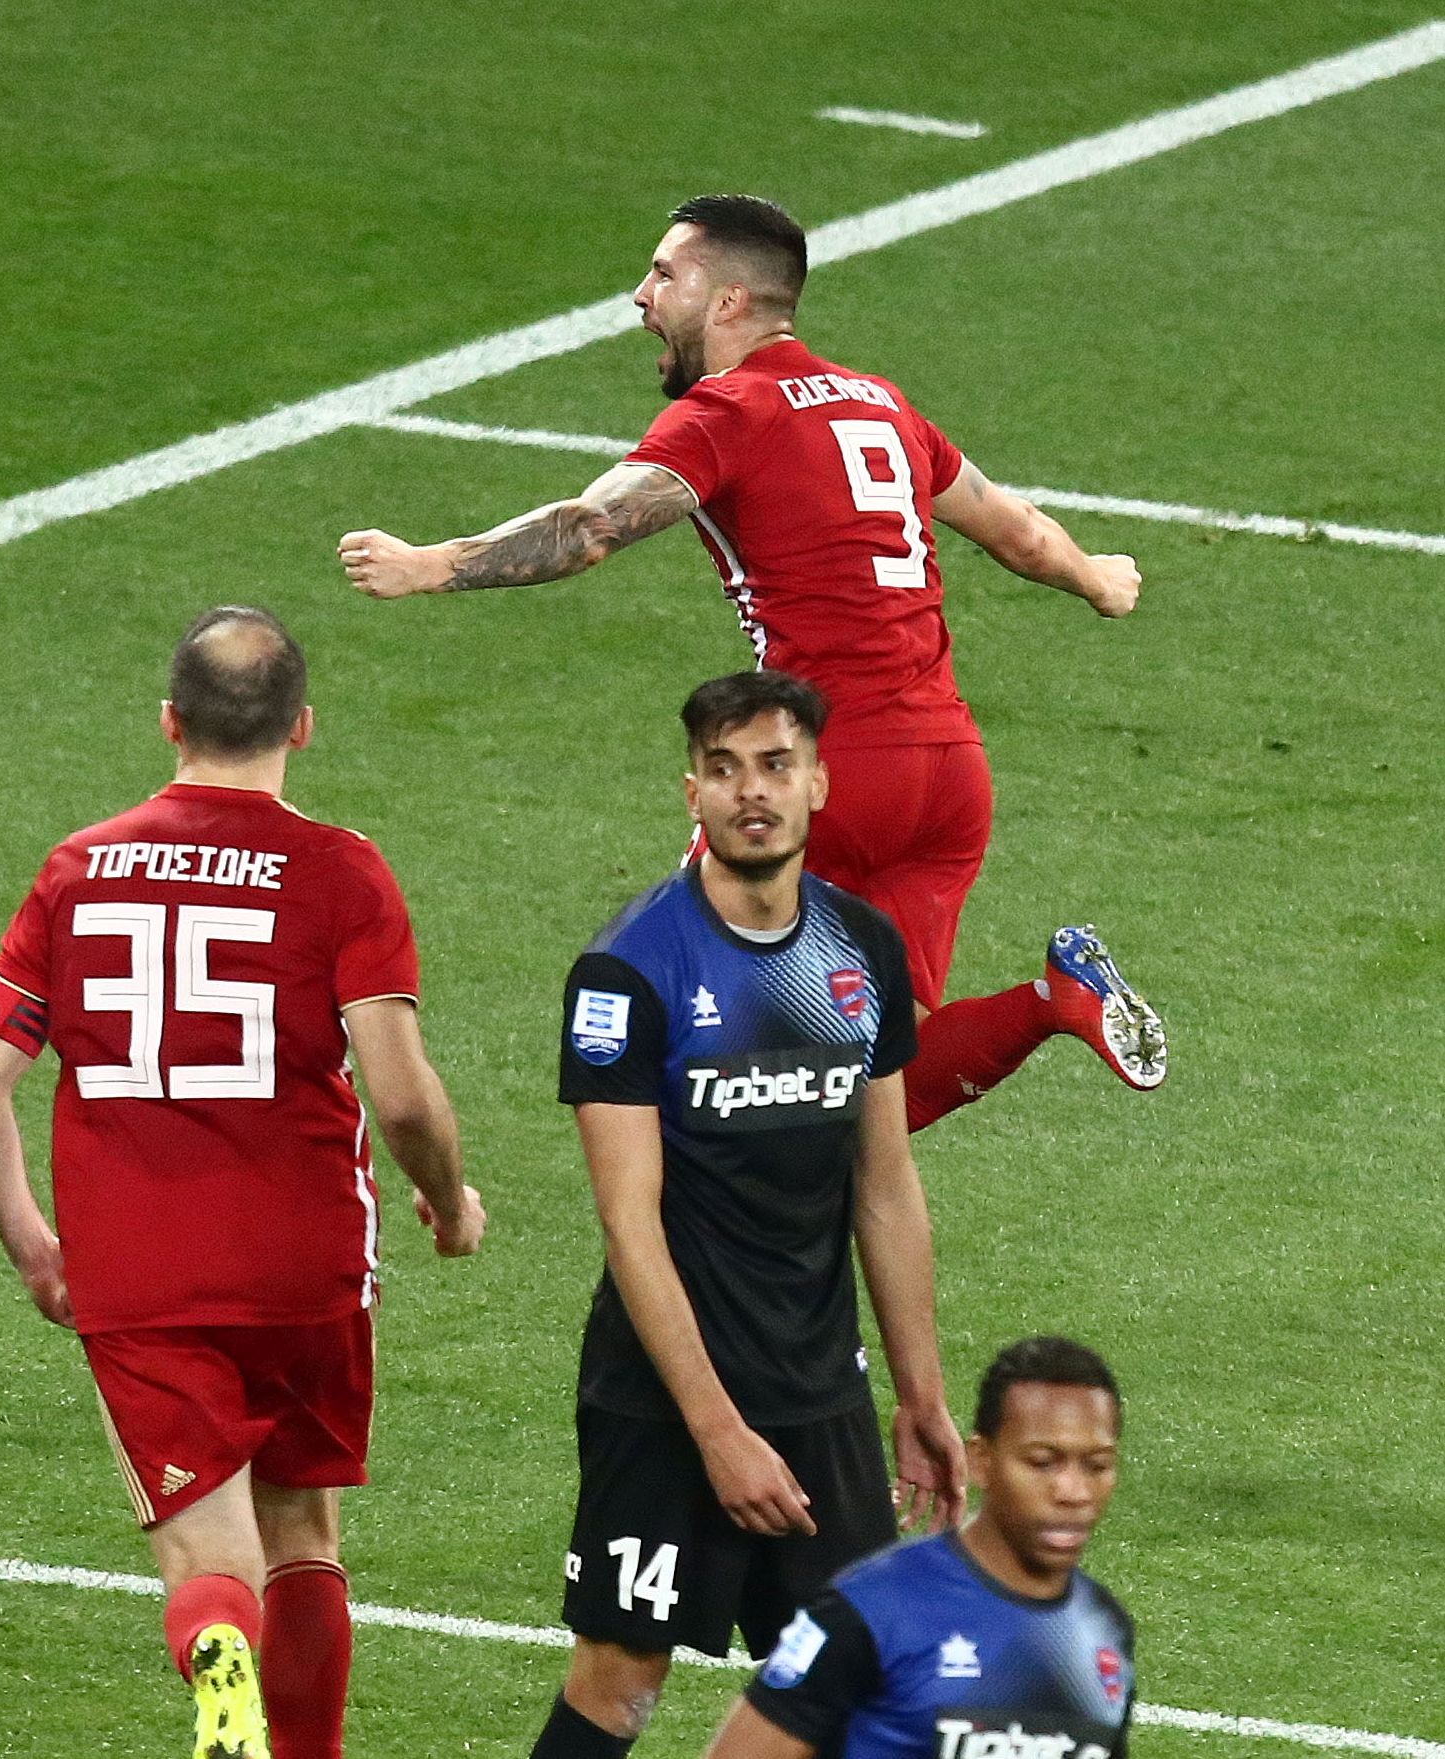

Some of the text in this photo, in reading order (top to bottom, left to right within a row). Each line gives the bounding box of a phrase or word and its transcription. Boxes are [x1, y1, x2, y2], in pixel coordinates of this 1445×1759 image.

[828, 419, 928, 589] 9
[72, 903, 276, 1100] 35
[608, 1536, 679, 1621] 14
